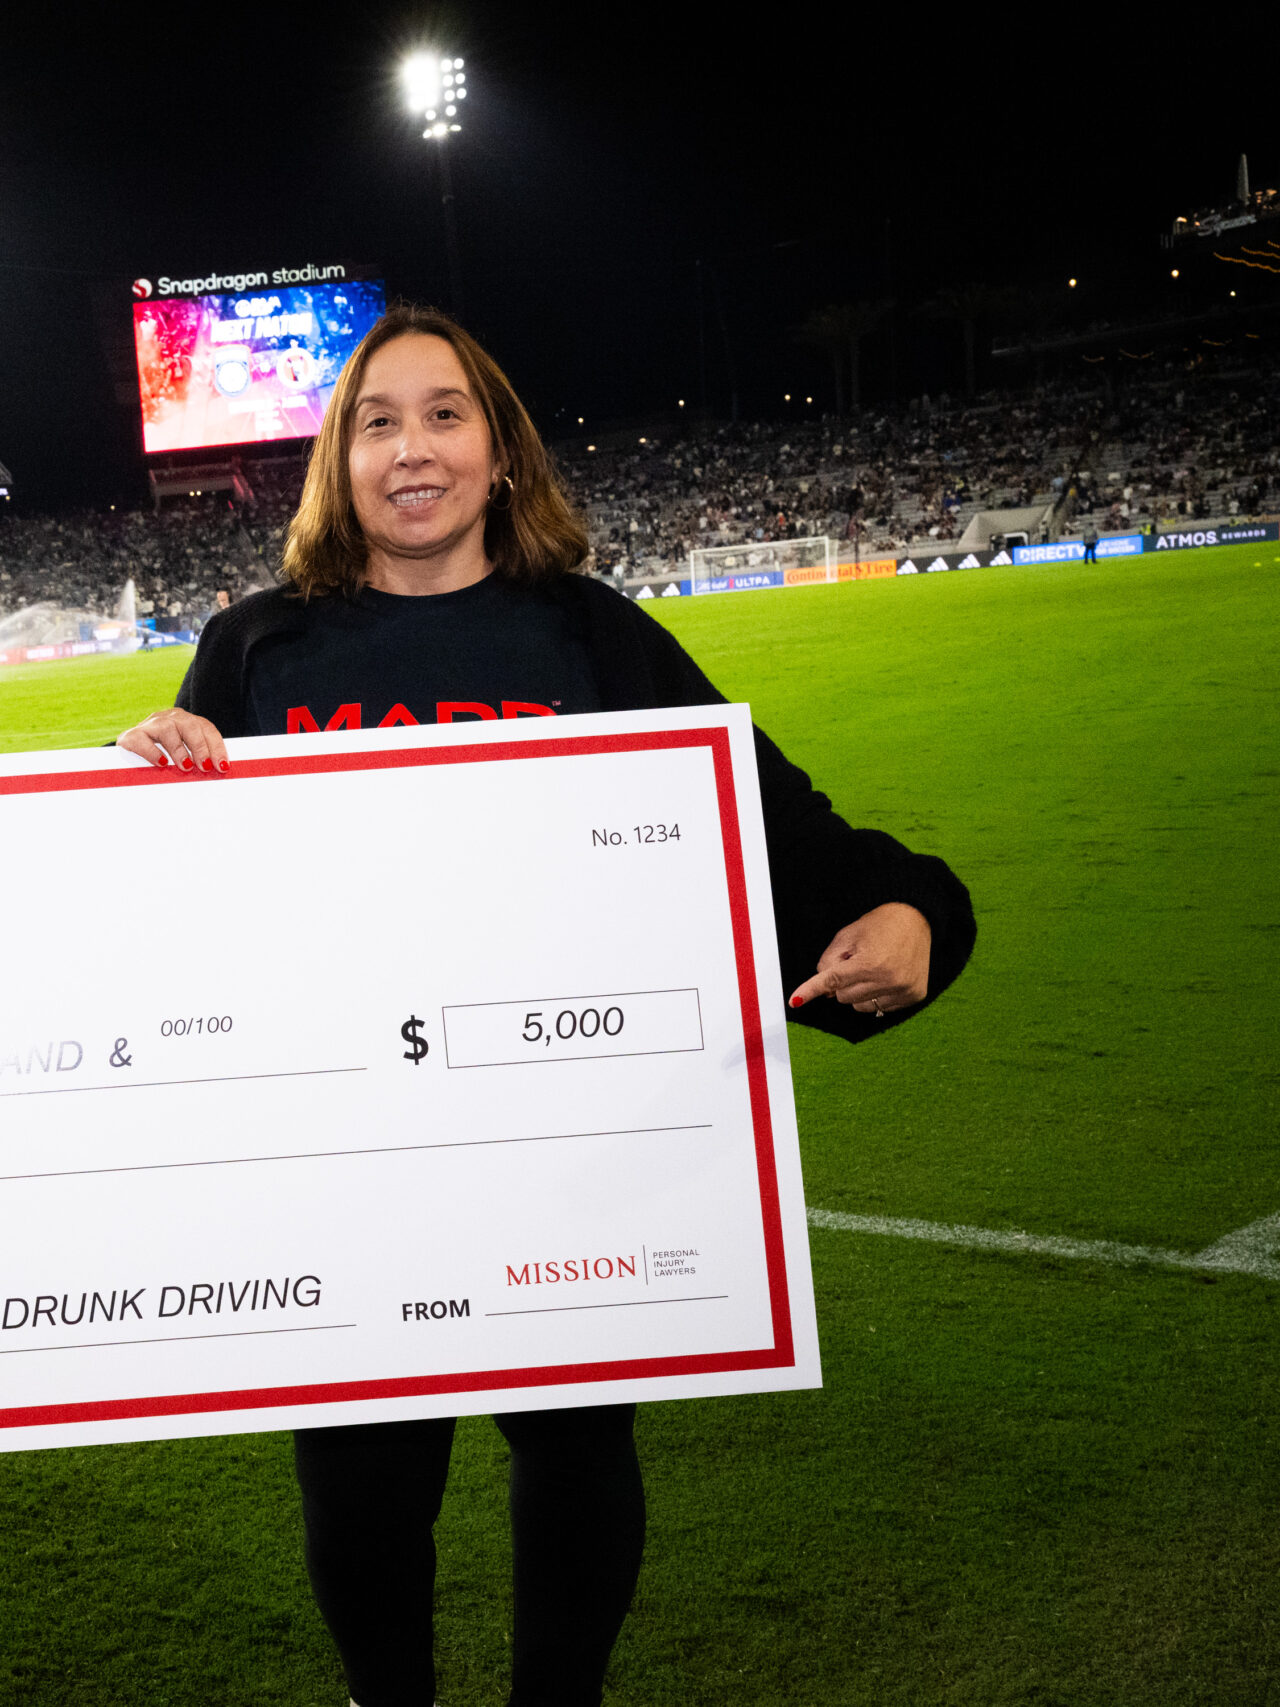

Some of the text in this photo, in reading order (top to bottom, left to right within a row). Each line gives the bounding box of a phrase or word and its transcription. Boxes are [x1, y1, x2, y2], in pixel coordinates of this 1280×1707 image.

[157, 264, 346, 296] Snapdragon stadium
[1156, 531, 1217, 549] ATMOS
[592, 823, 682, 847] No. 1234
[160, 1015, 233, 1037] 00/100
[401, 1007, 624, 1065] $ 5,000
[108, 1037, 133, 1068] &
[653, 1249, 700, 1259] PERSONAL
[654, 1259, 685, 1268] INJURY
[506, 1255, 636, 1287] MISSION
[654, 1267, 696, 1277] LAWYERS
[1, 1287, 145, 1331] DRUNK
[157, 1275, 322, 1319] DRIVING
[401, 1299, 471, 1322] FROM
